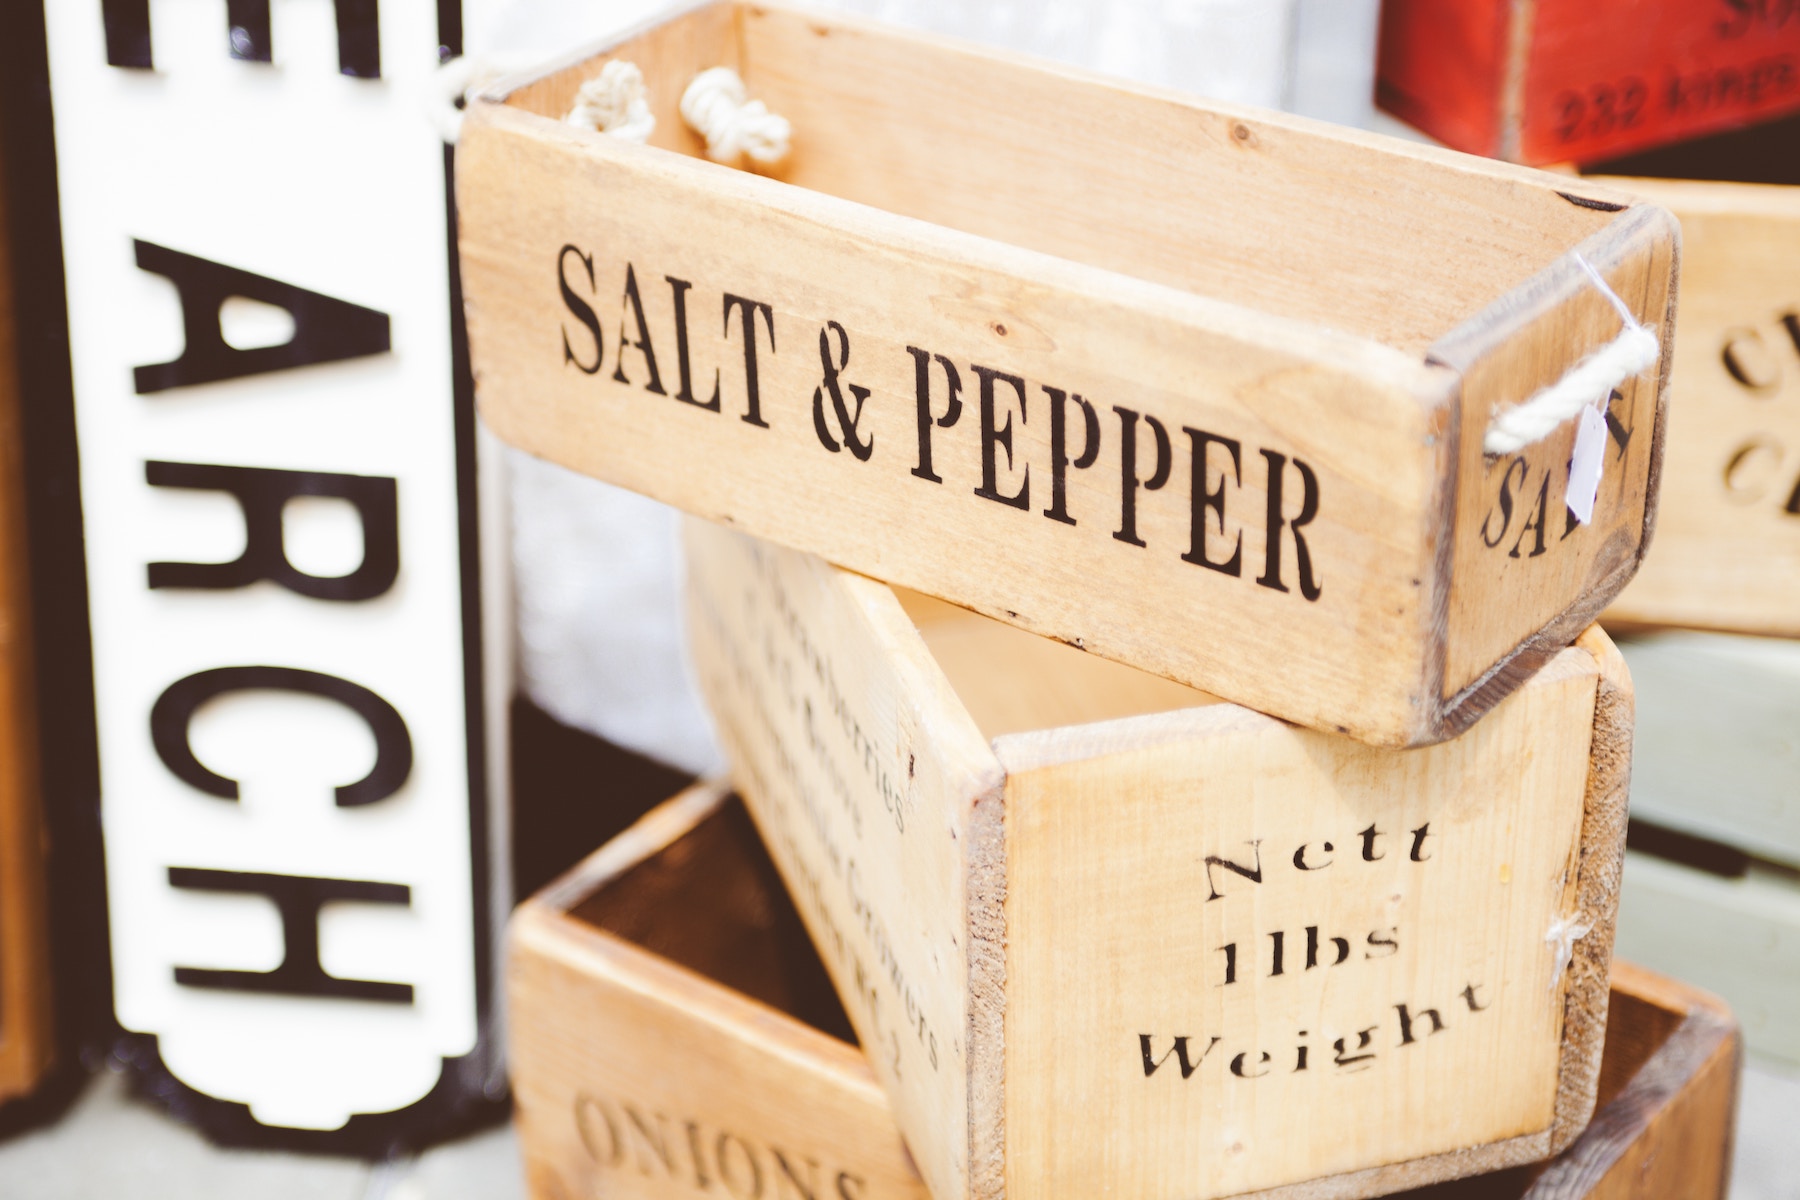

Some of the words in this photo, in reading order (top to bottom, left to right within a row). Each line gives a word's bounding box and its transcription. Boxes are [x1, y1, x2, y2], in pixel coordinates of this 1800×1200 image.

[557, 243, 776, 429] SALT
[812, 320, 873, 462] &
[906, 345, 1322, 602] PEPPER
[131, 236, 415, 1005] ARCH
[1197, 822, 1437, 903] Nett
[1138, 981, 1492, 1079] Weight
